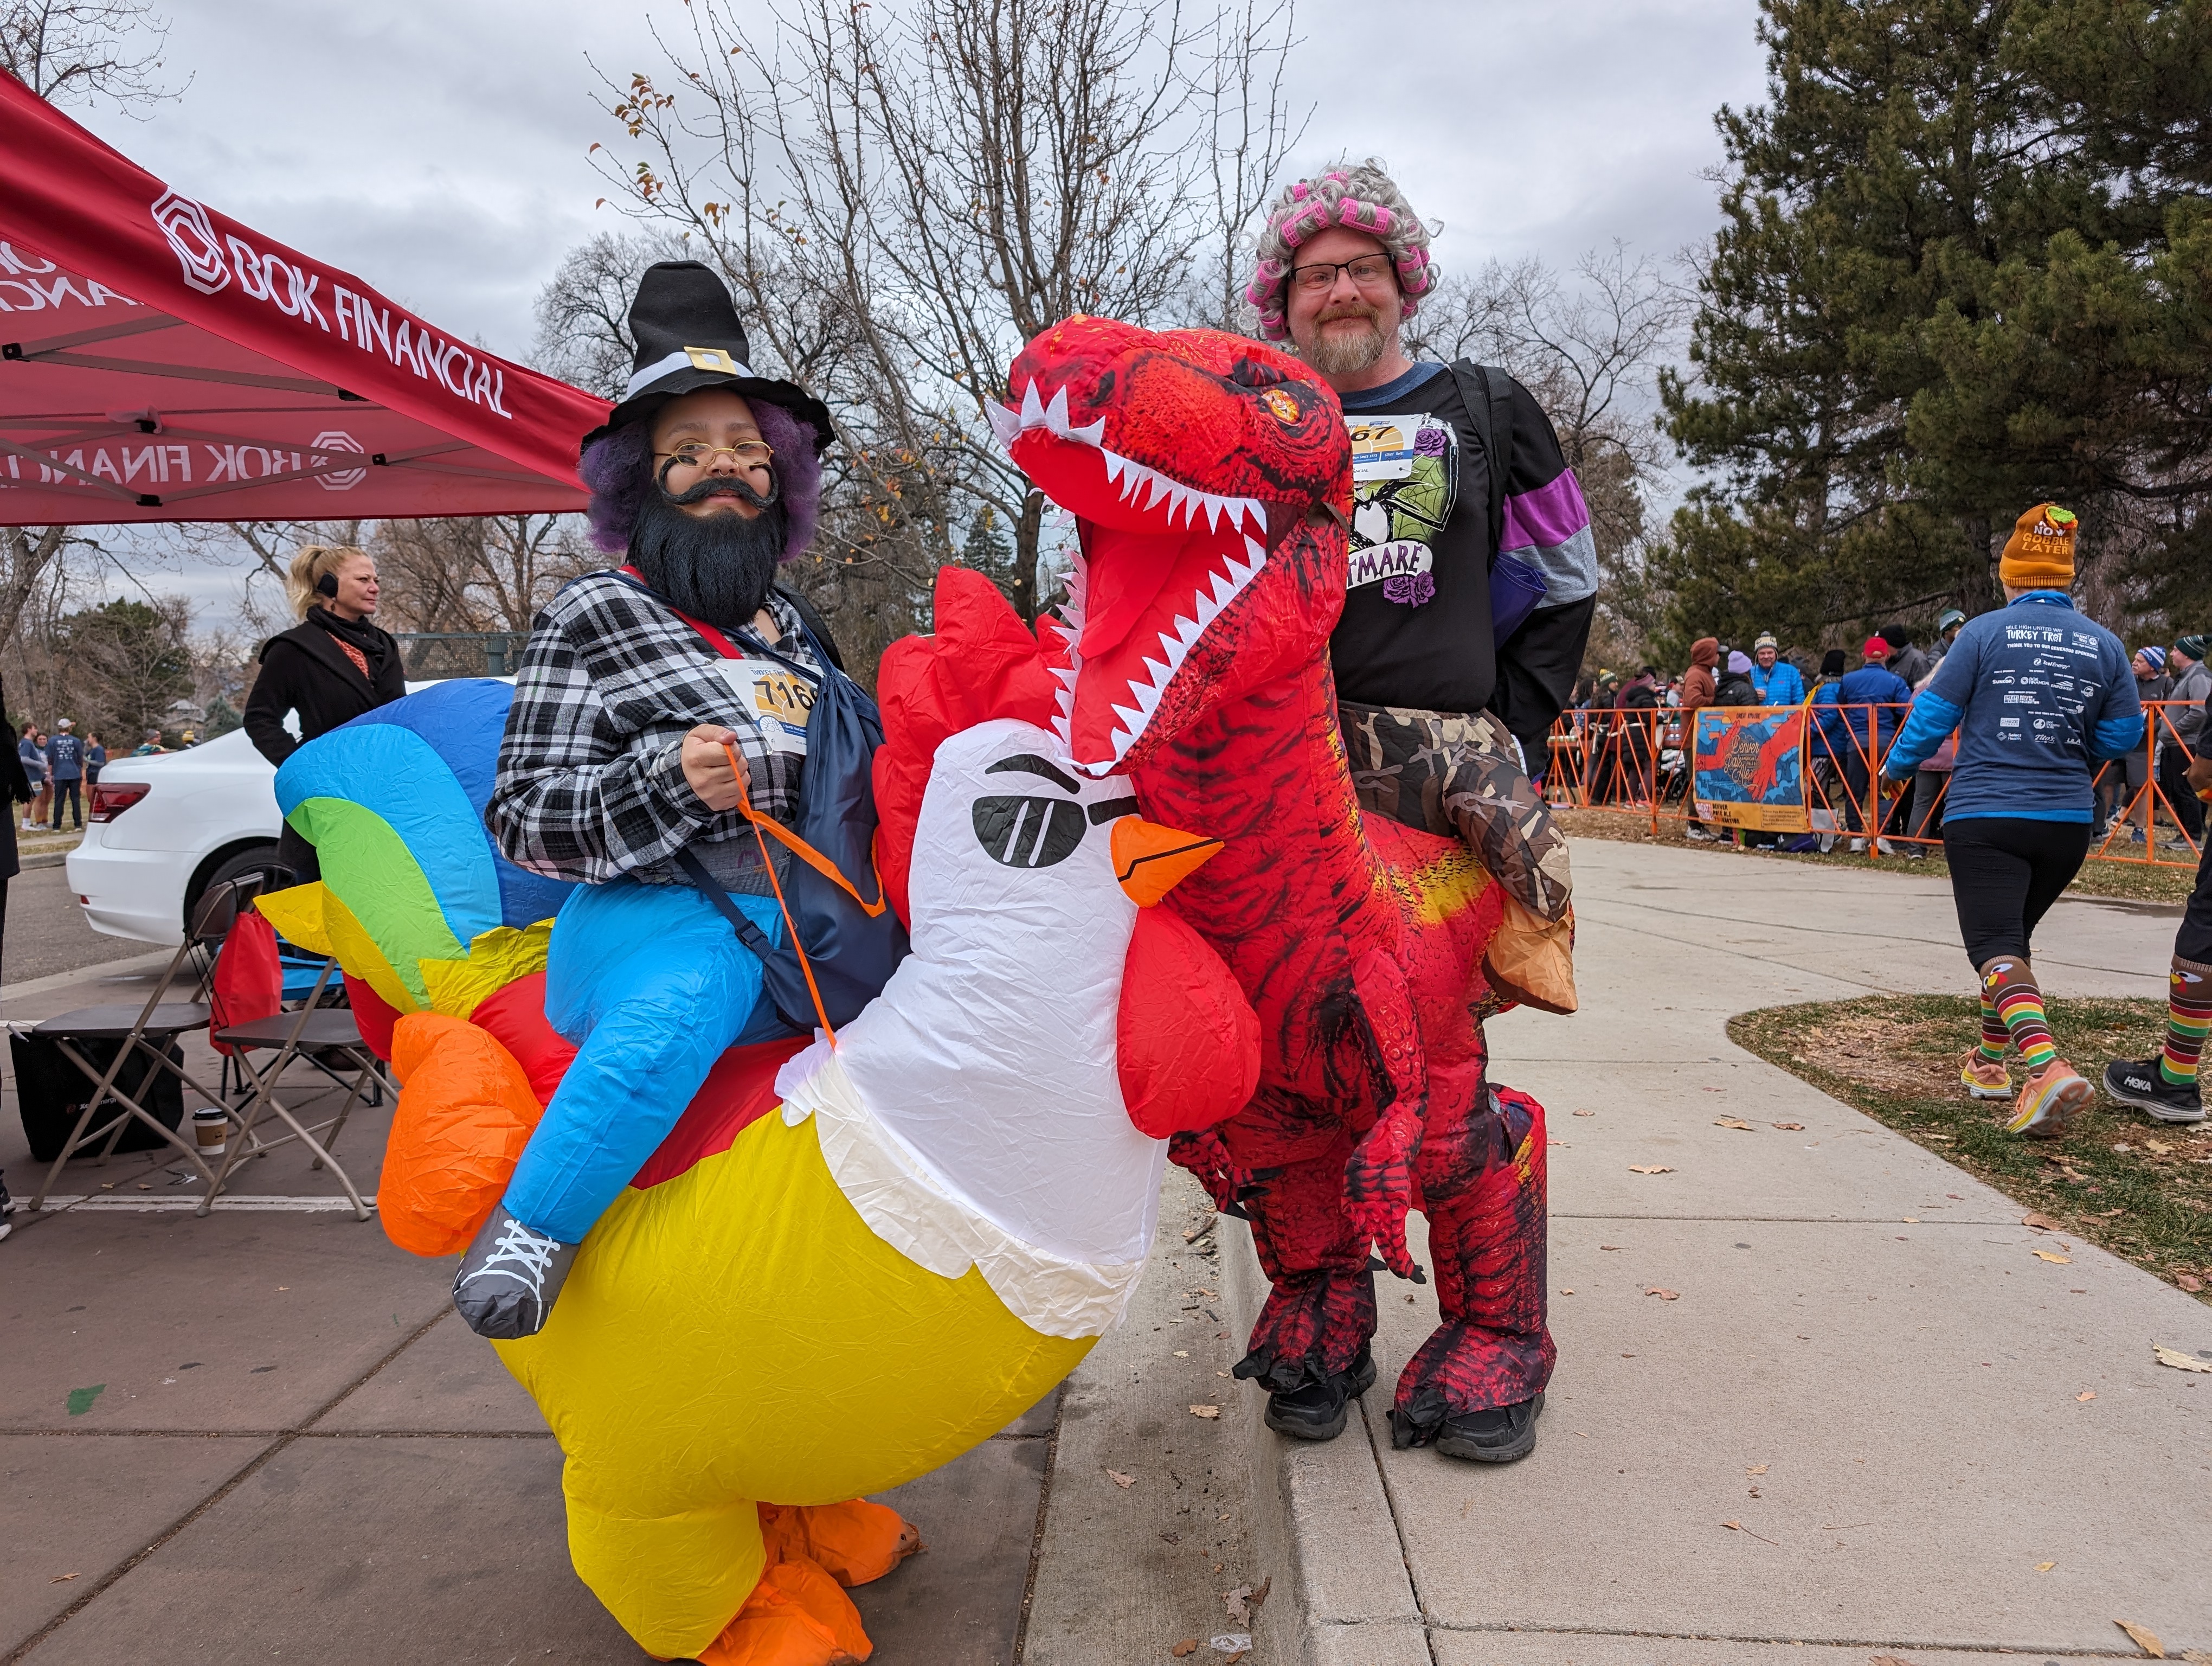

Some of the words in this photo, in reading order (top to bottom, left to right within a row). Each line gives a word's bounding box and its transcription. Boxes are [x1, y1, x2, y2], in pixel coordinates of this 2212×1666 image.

[226, 233, 330, 333] BOK
[334, 284, 512, 420] FINANCIAL
[2034, 525, 2066, 536] NOW
[2022, 533, 2070, 546] GOBBLE
[2022, 542, 2068, 554] LATER
[2006, 630, 2039, 640] TURKEY
[2042, 631, 2063, 643] TROT
[2051, 645, 2074, 653] GENEROUS
[2075, 650, 2098, 659] SPONSORS
[1731, 734, 1760, 754] Denver
[1724, 753, 1742, 773] Pale
[2124, 1075, 2152, 1092] HOKA
